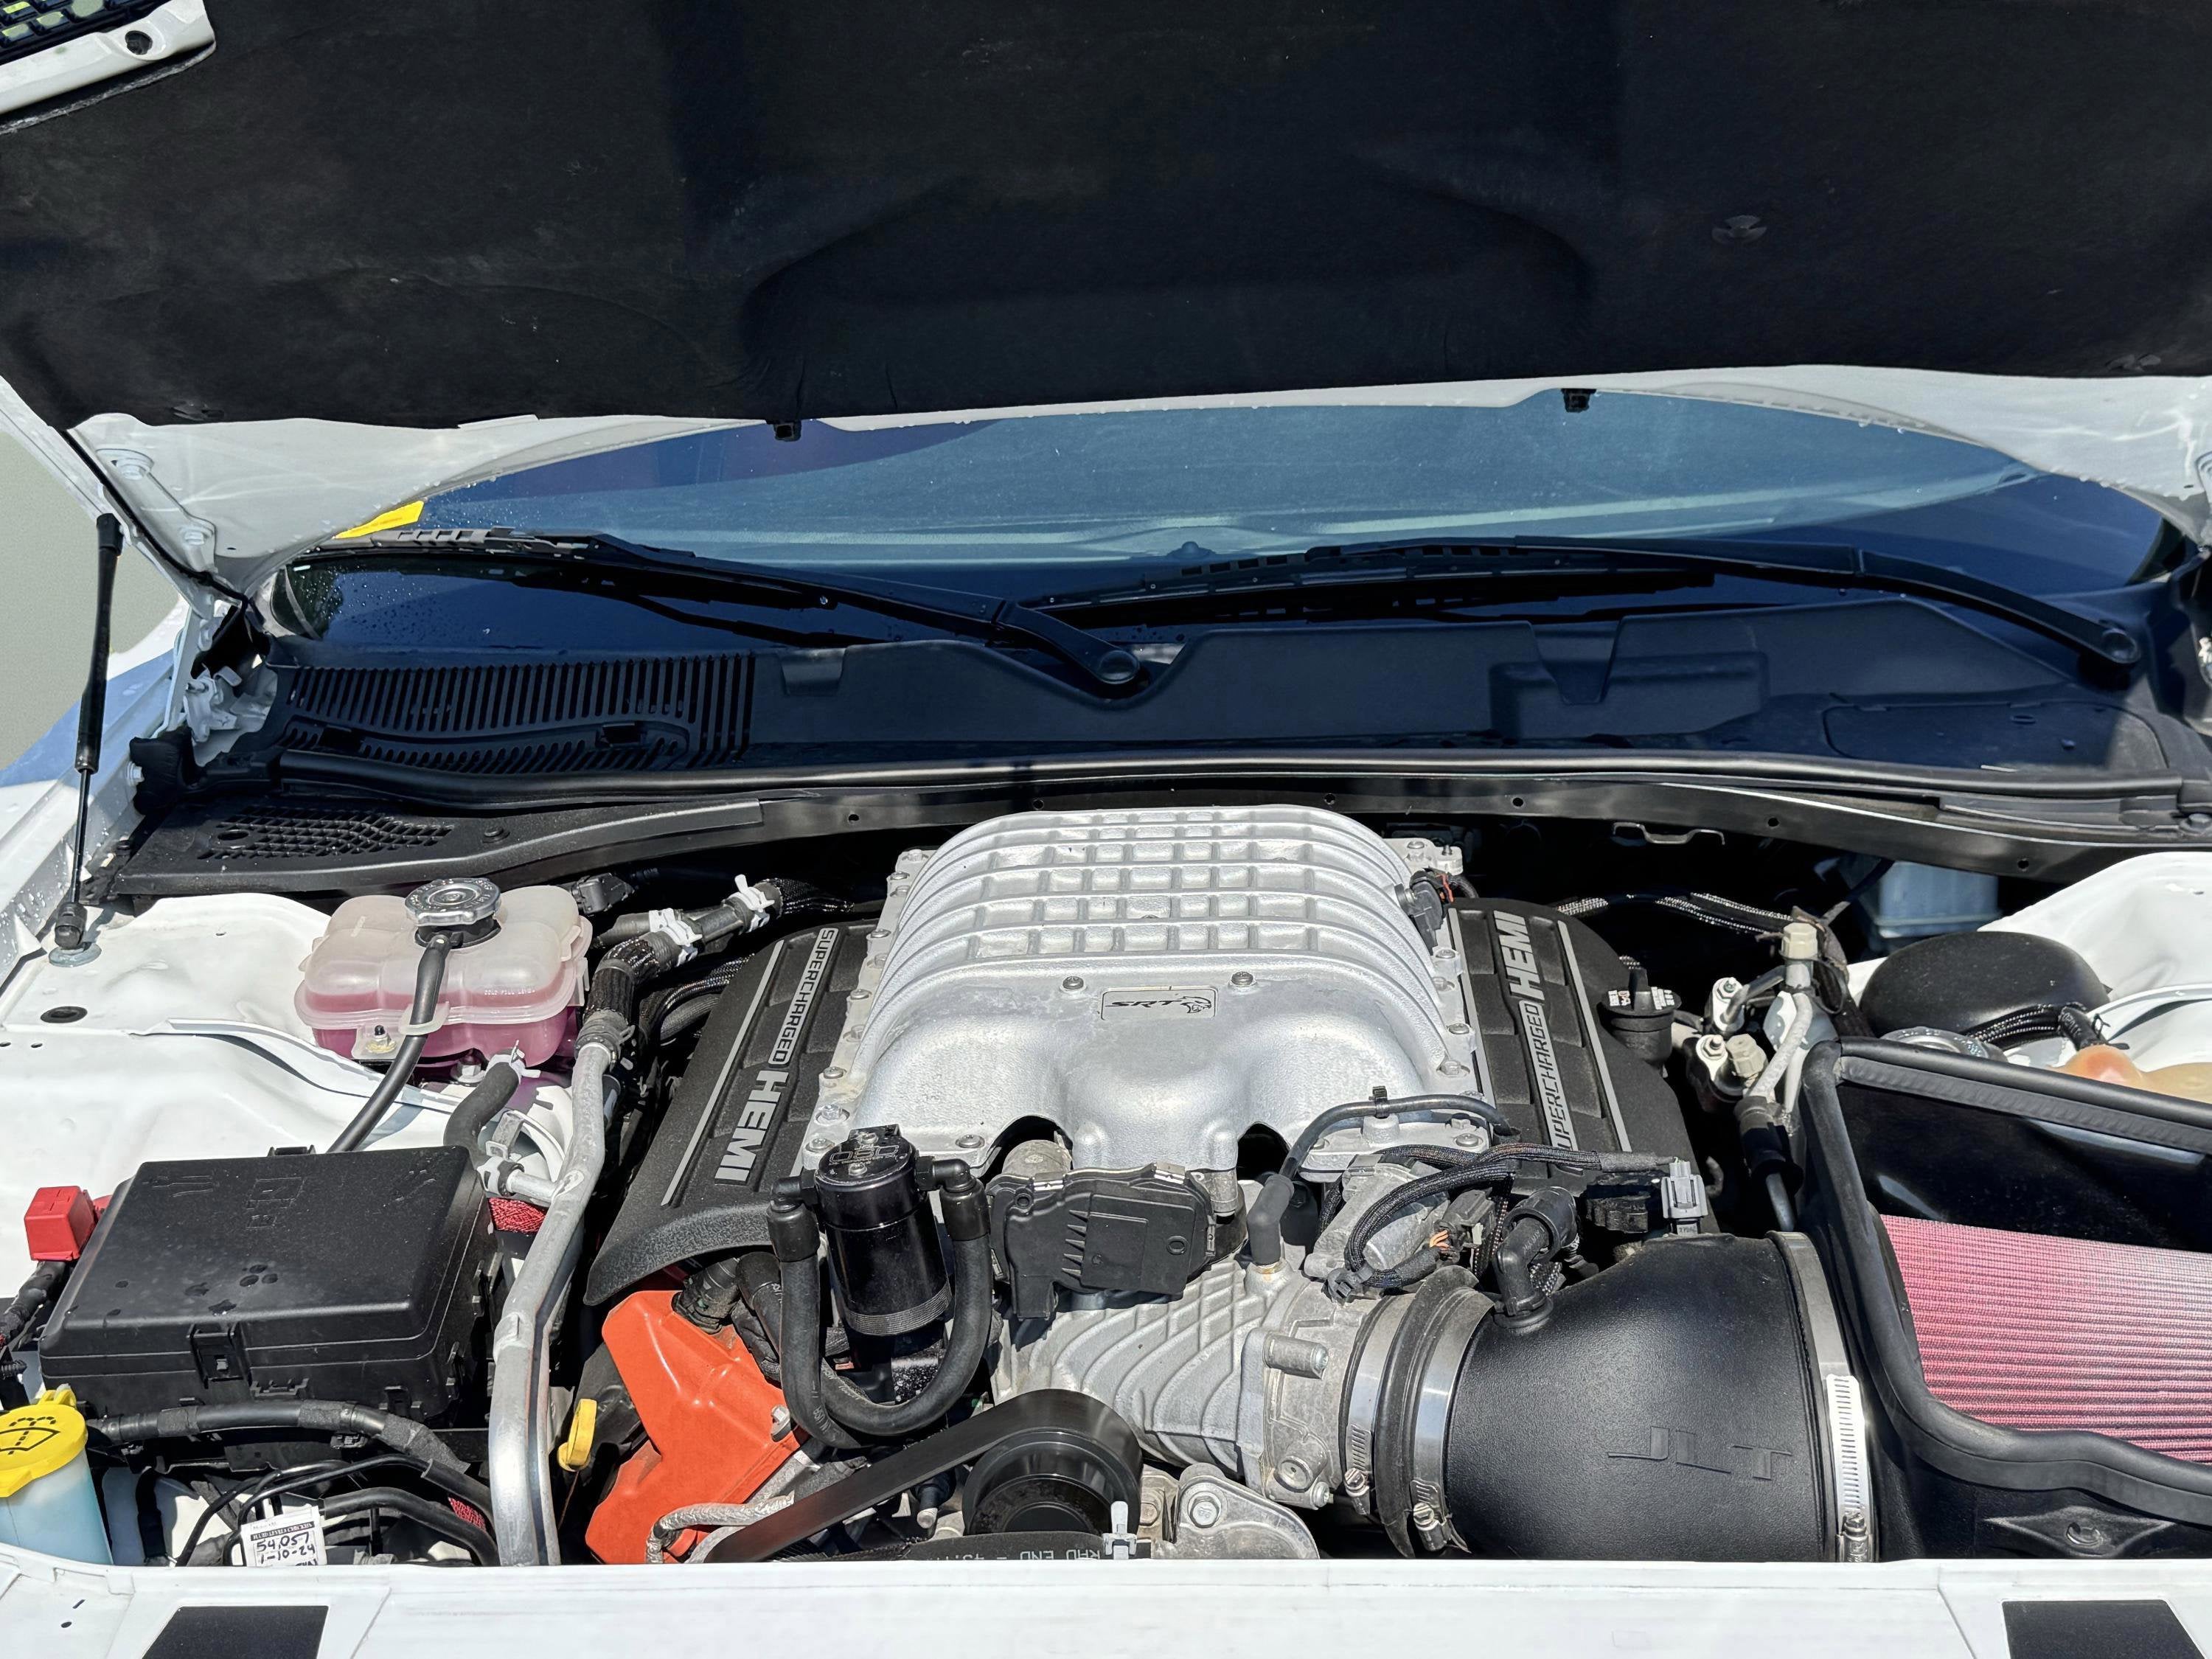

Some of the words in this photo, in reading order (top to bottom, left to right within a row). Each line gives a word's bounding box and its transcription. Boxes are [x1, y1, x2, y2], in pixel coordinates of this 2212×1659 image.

[771, 928, 835, 1062] SUPERCHARGED
[1105, 1000, 1182, 1008] SRT
[1493, 910, 1545, 1001] HEMI
[714, 1070, 790, 1183] HEMI
[1523, 1001, 1573, 1151] UPERCHARGED
